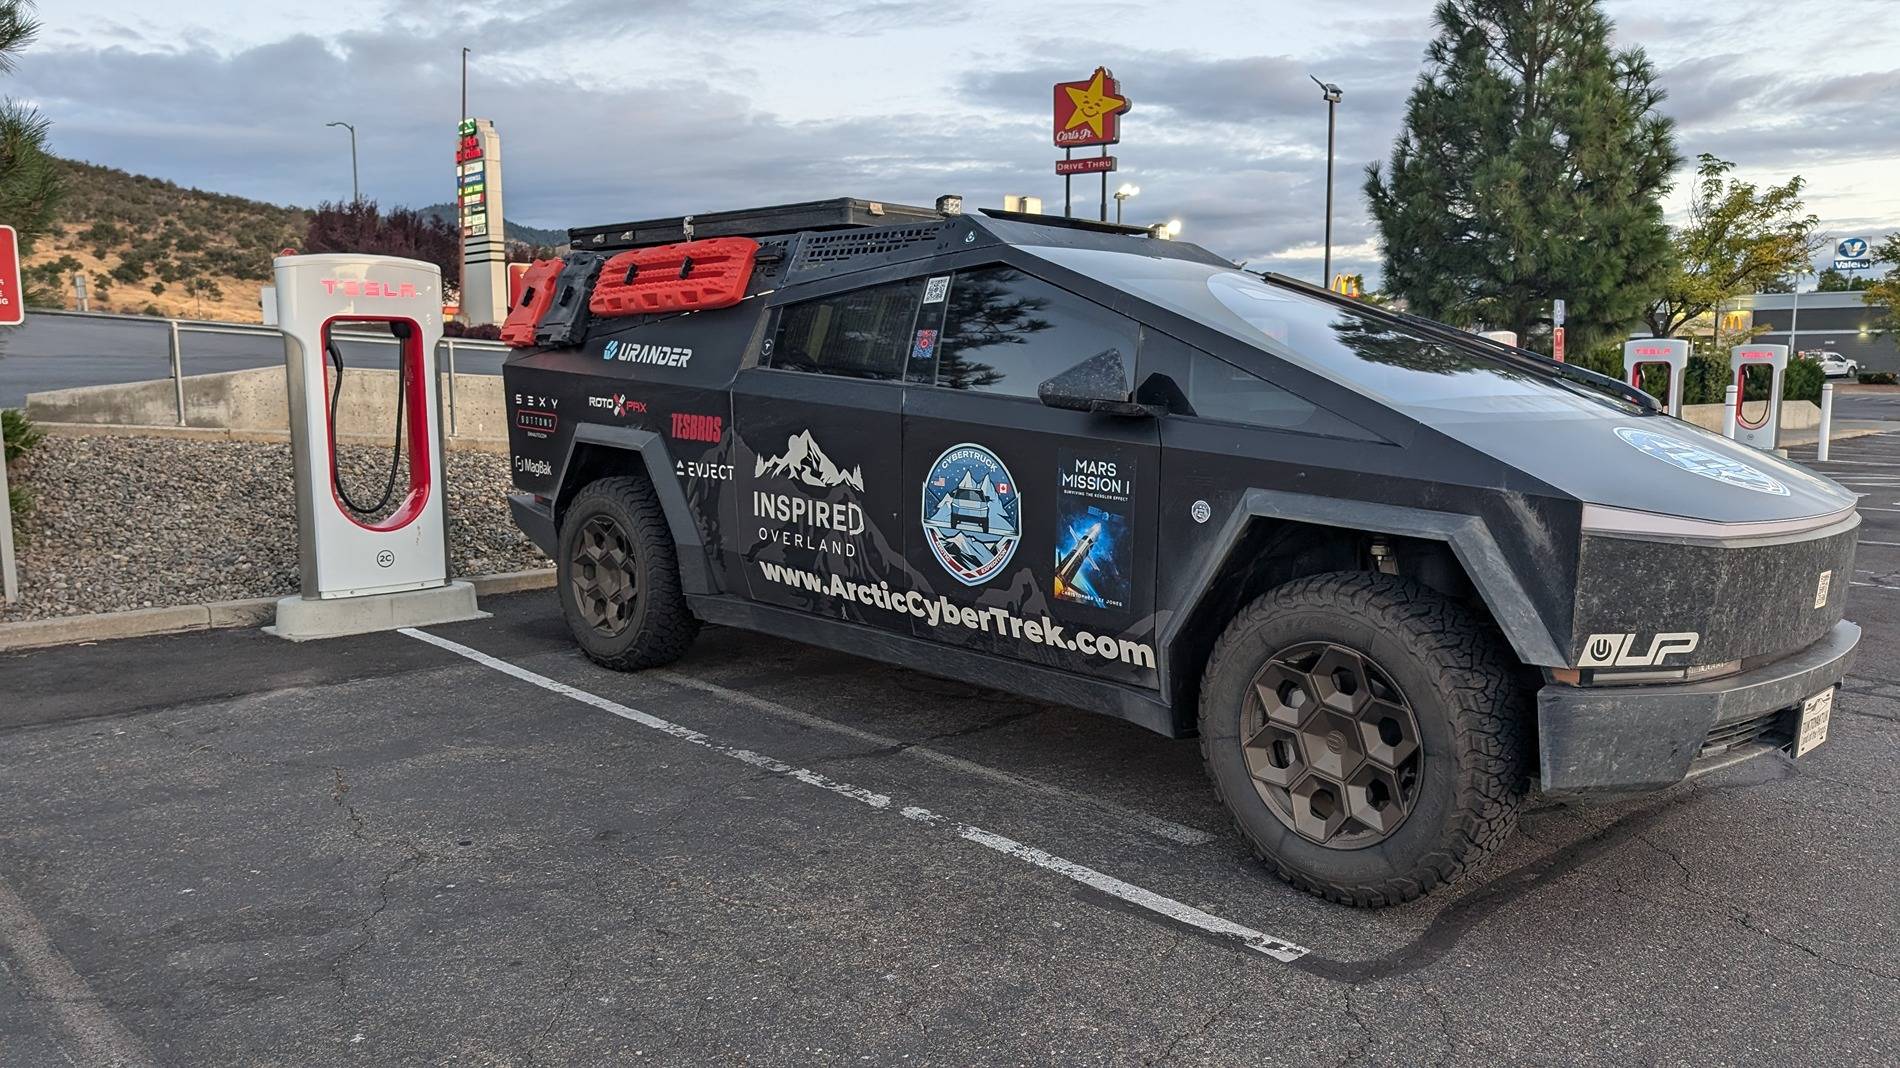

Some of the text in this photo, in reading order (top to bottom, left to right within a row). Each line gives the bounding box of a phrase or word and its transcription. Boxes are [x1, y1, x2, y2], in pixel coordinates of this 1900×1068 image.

[1057, 160, 1111, 171] DRIVE THRU
[320, 279, 417, 299] TESLA
[618, 343, 692, 367] URANDER
[521, 415, 552, 428] BUTTONS
[671, 413, 722, 443] TESBROS
[524, 458, 552, 477] MagBak
[688, 461, 734, 480] EVJECT
[941, 450, 998, 473] CYBERTRUCK
[1075, 459, 1117, 476] MARS
[1062, 473, 1121, 493] MISSION
[753, 491, 865, 535] INSPIRED
[758, 527, 855, 557] OVERLAND
[380, 554, 391, 562] 2C
[1105, 599, 1122, 607] JONES
[759, 561, 1156, 669] www.ArcticCyberTrek.com
